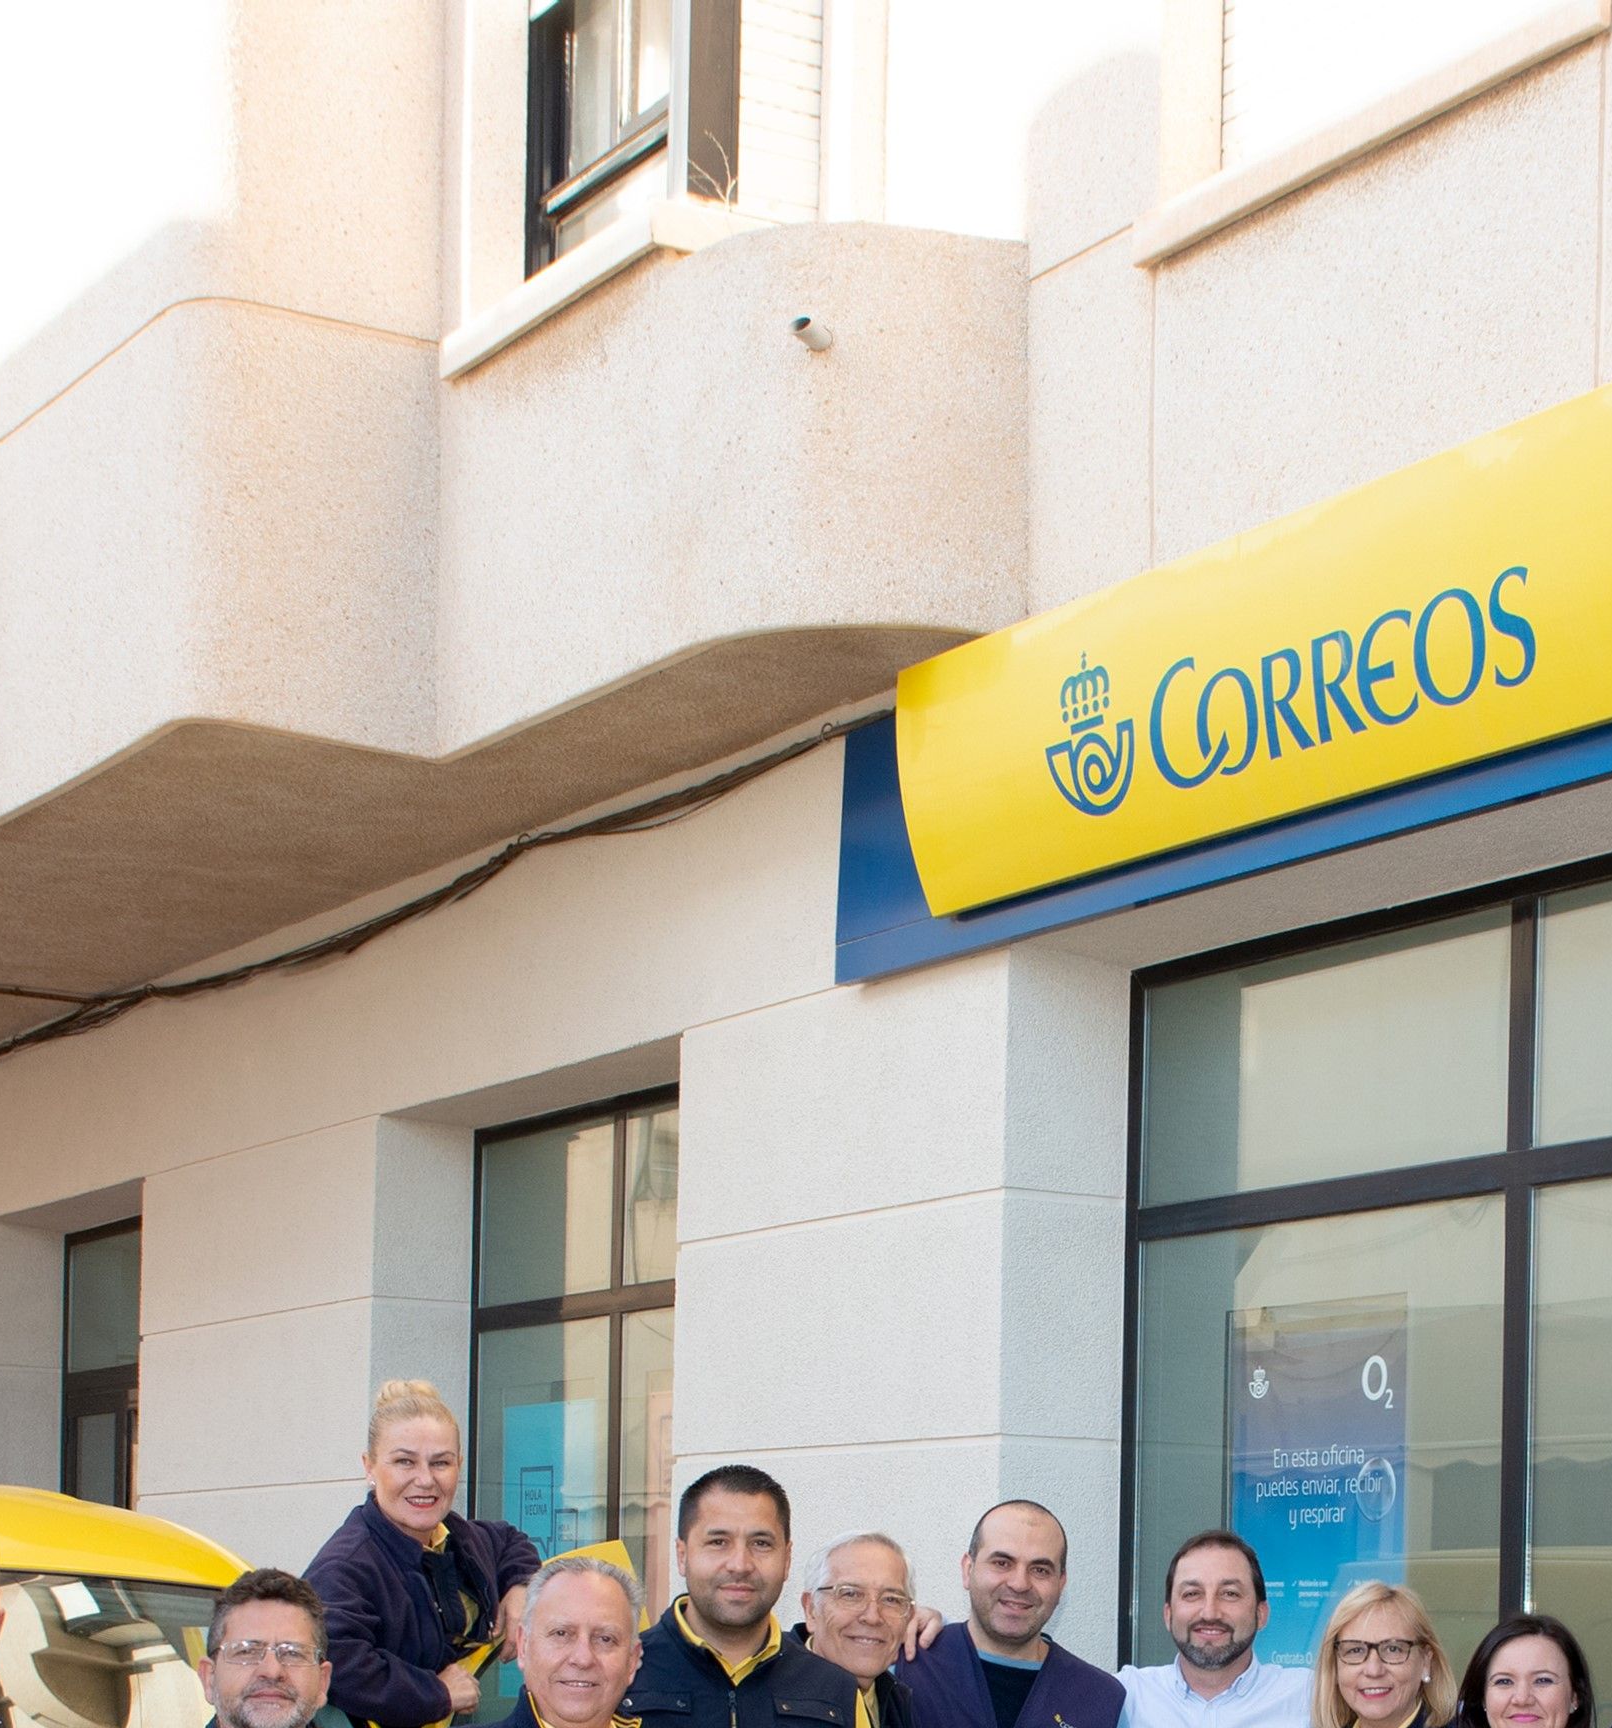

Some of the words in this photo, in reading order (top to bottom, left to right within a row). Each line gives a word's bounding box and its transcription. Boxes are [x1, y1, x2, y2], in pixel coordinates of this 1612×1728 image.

[1150, 567, 1536, 788] CORREOS
[1273, 1448, 1288, 1469] En
[1291, 1449, 1318, 1468] esta
[1321, 1444, 1365, 1467] oficina
[1256, 1476, 1299, 1503] puedes
[1301, 1474, 1341, 1497] enviar,
[1344, 1470, 1383, 1494] recibir
[1289, 1510, 1297, 1530] y
[1300, 1504, 1346, 1528] respirar
[1271, 1651, 1304, 1665] Contrata
